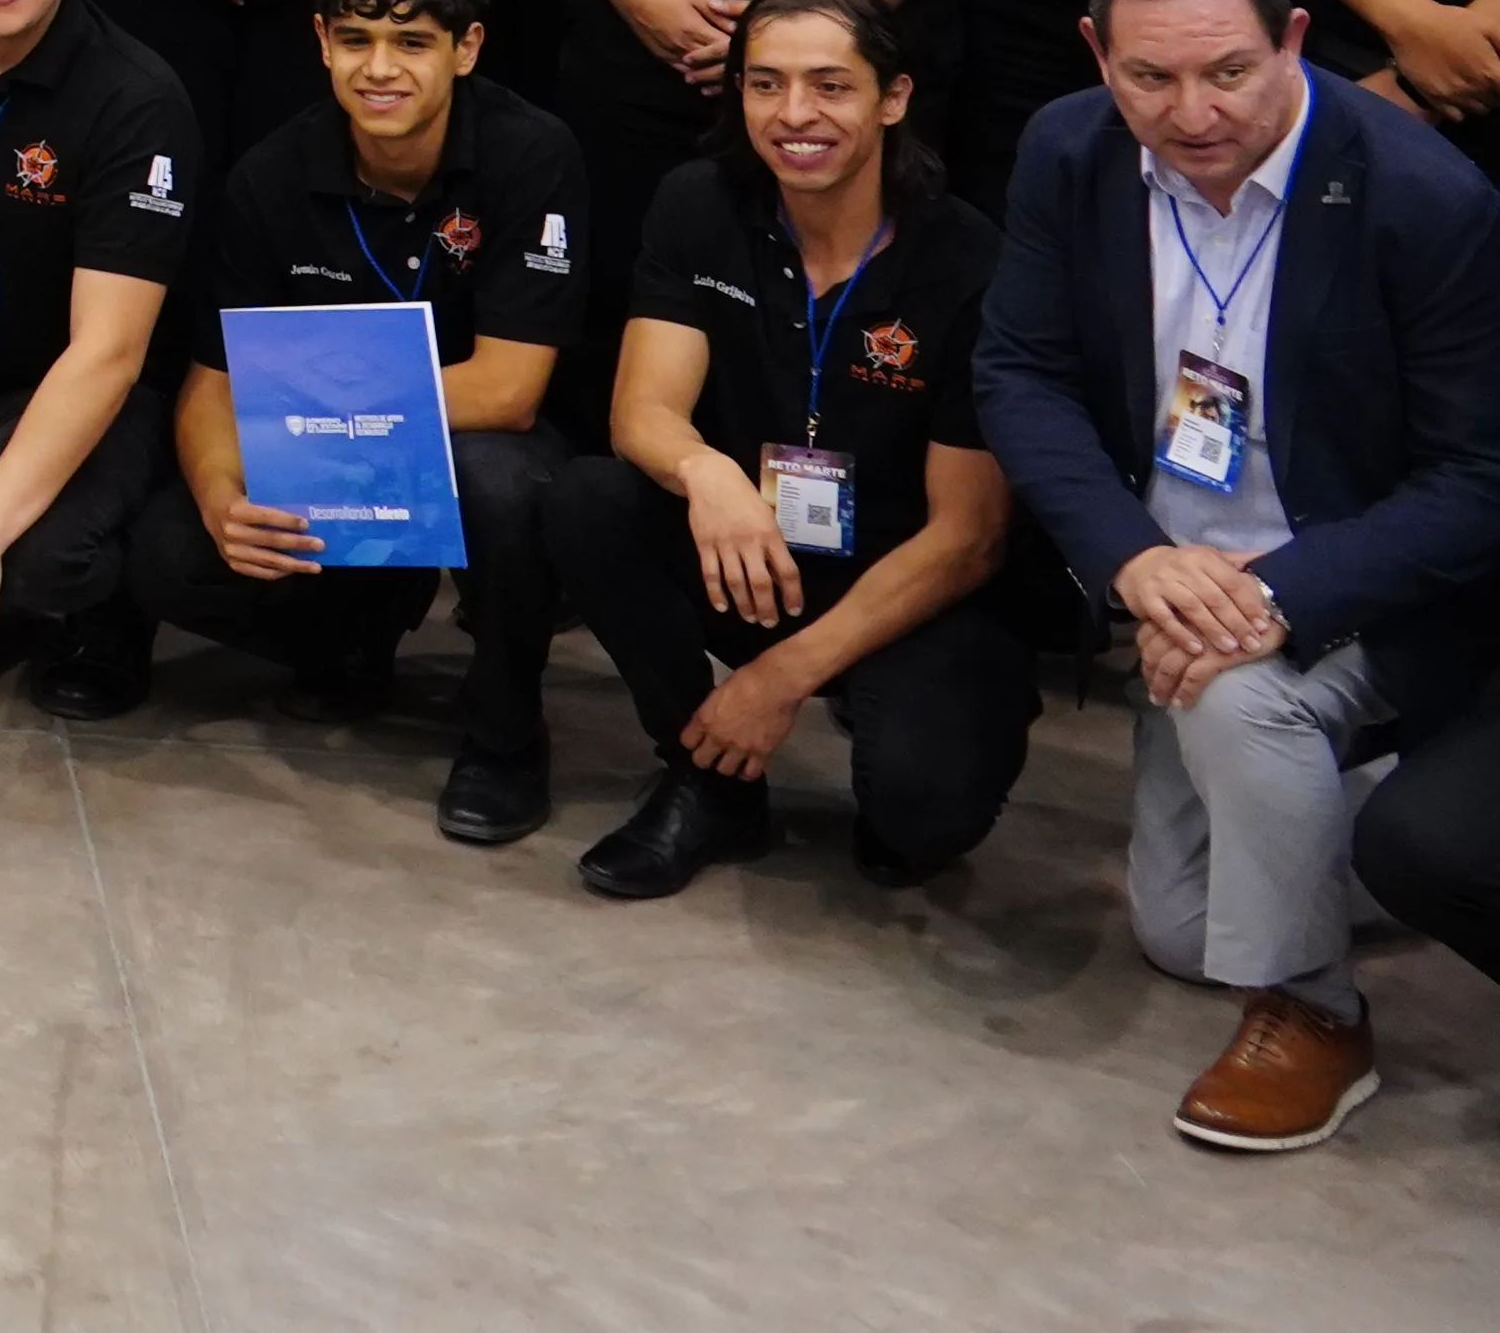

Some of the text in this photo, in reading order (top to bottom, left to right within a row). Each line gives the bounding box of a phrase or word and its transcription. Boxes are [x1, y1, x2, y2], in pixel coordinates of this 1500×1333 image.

[1183, 366, 1242, 402] RETO MARTE
[768, 460, 846, 479] RETO MARTE
